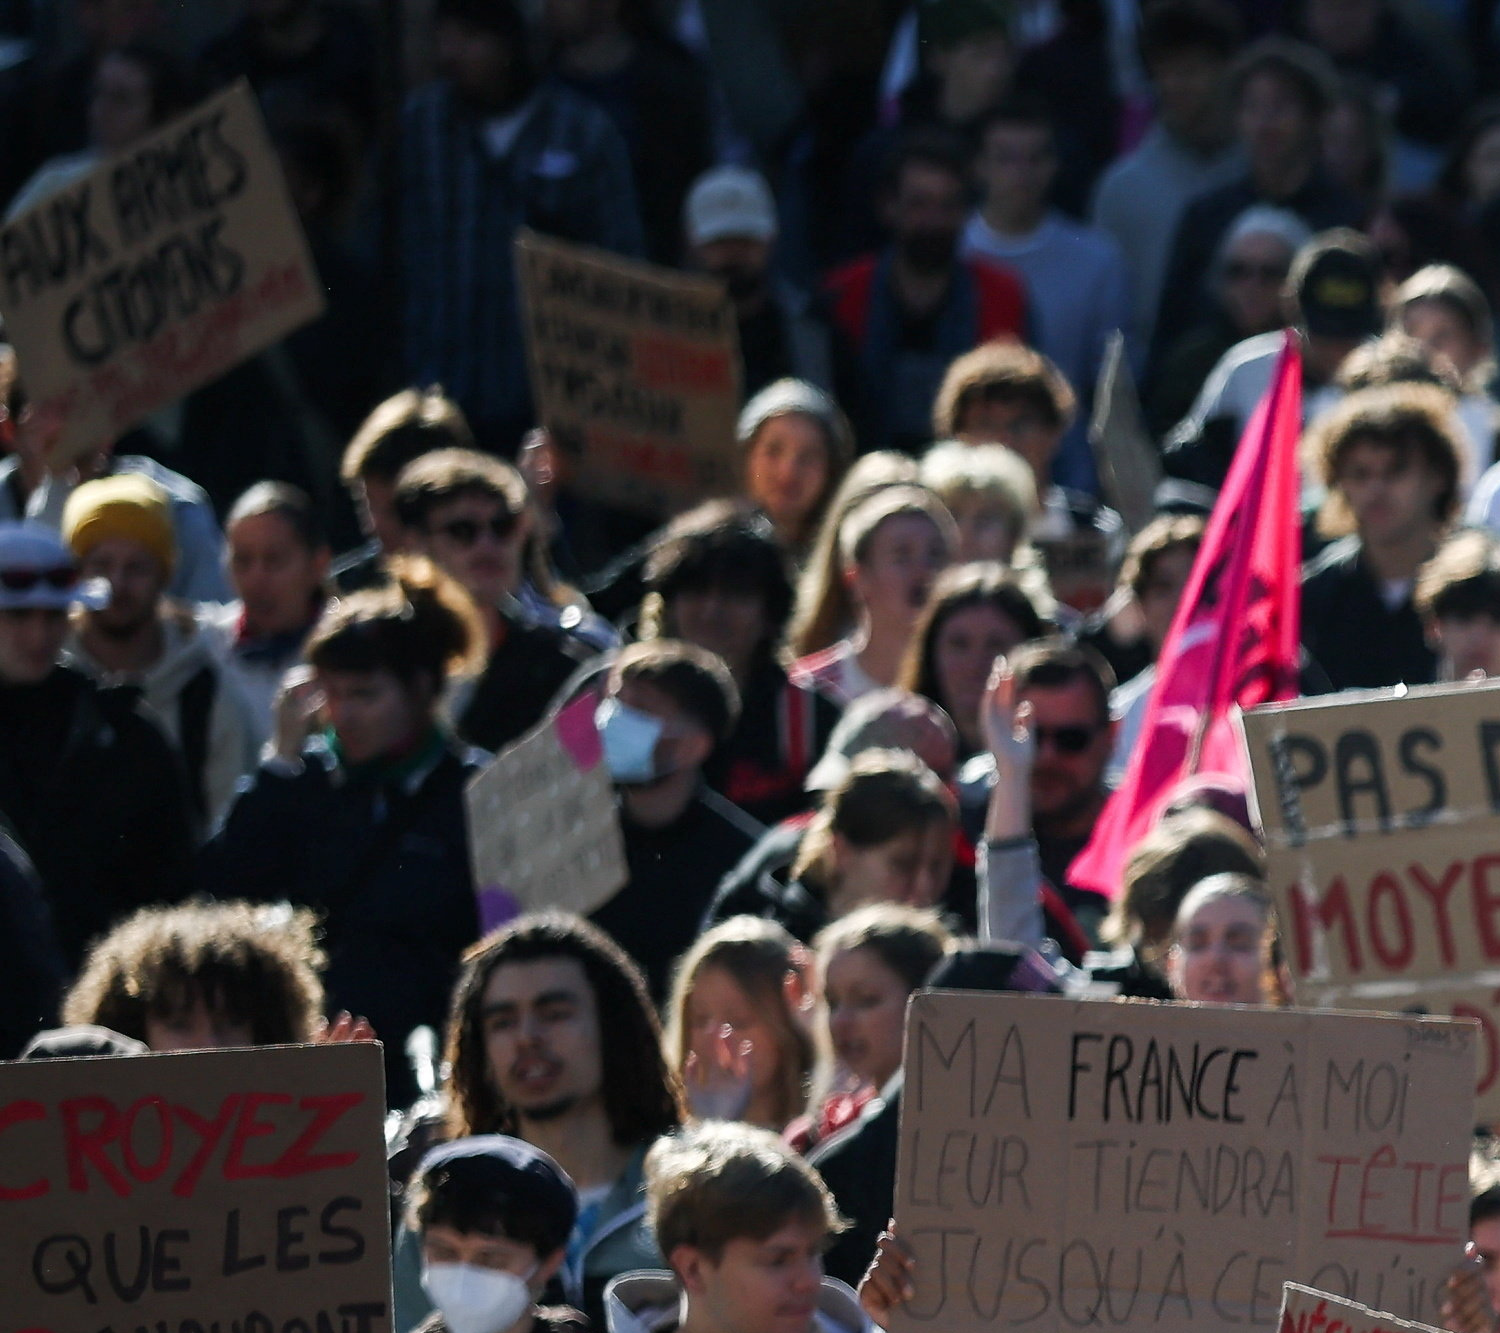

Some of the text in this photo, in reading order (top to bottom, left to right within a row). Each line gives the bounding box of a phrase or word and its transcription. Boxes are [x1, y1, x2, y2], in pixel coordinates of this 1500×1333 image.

[1268, 726, 1447, 847] PAS
[915, 1017, 1302, 1131] MA FRANCE À
[0, 1089, 369, 1200] CROYEZ
[909, 1129, 1468, 1236] LEUR TÊTE
[31, 1195, 369, 1305] QUE LES
[902, 1225, 1194, 1328] JUSQU'À
